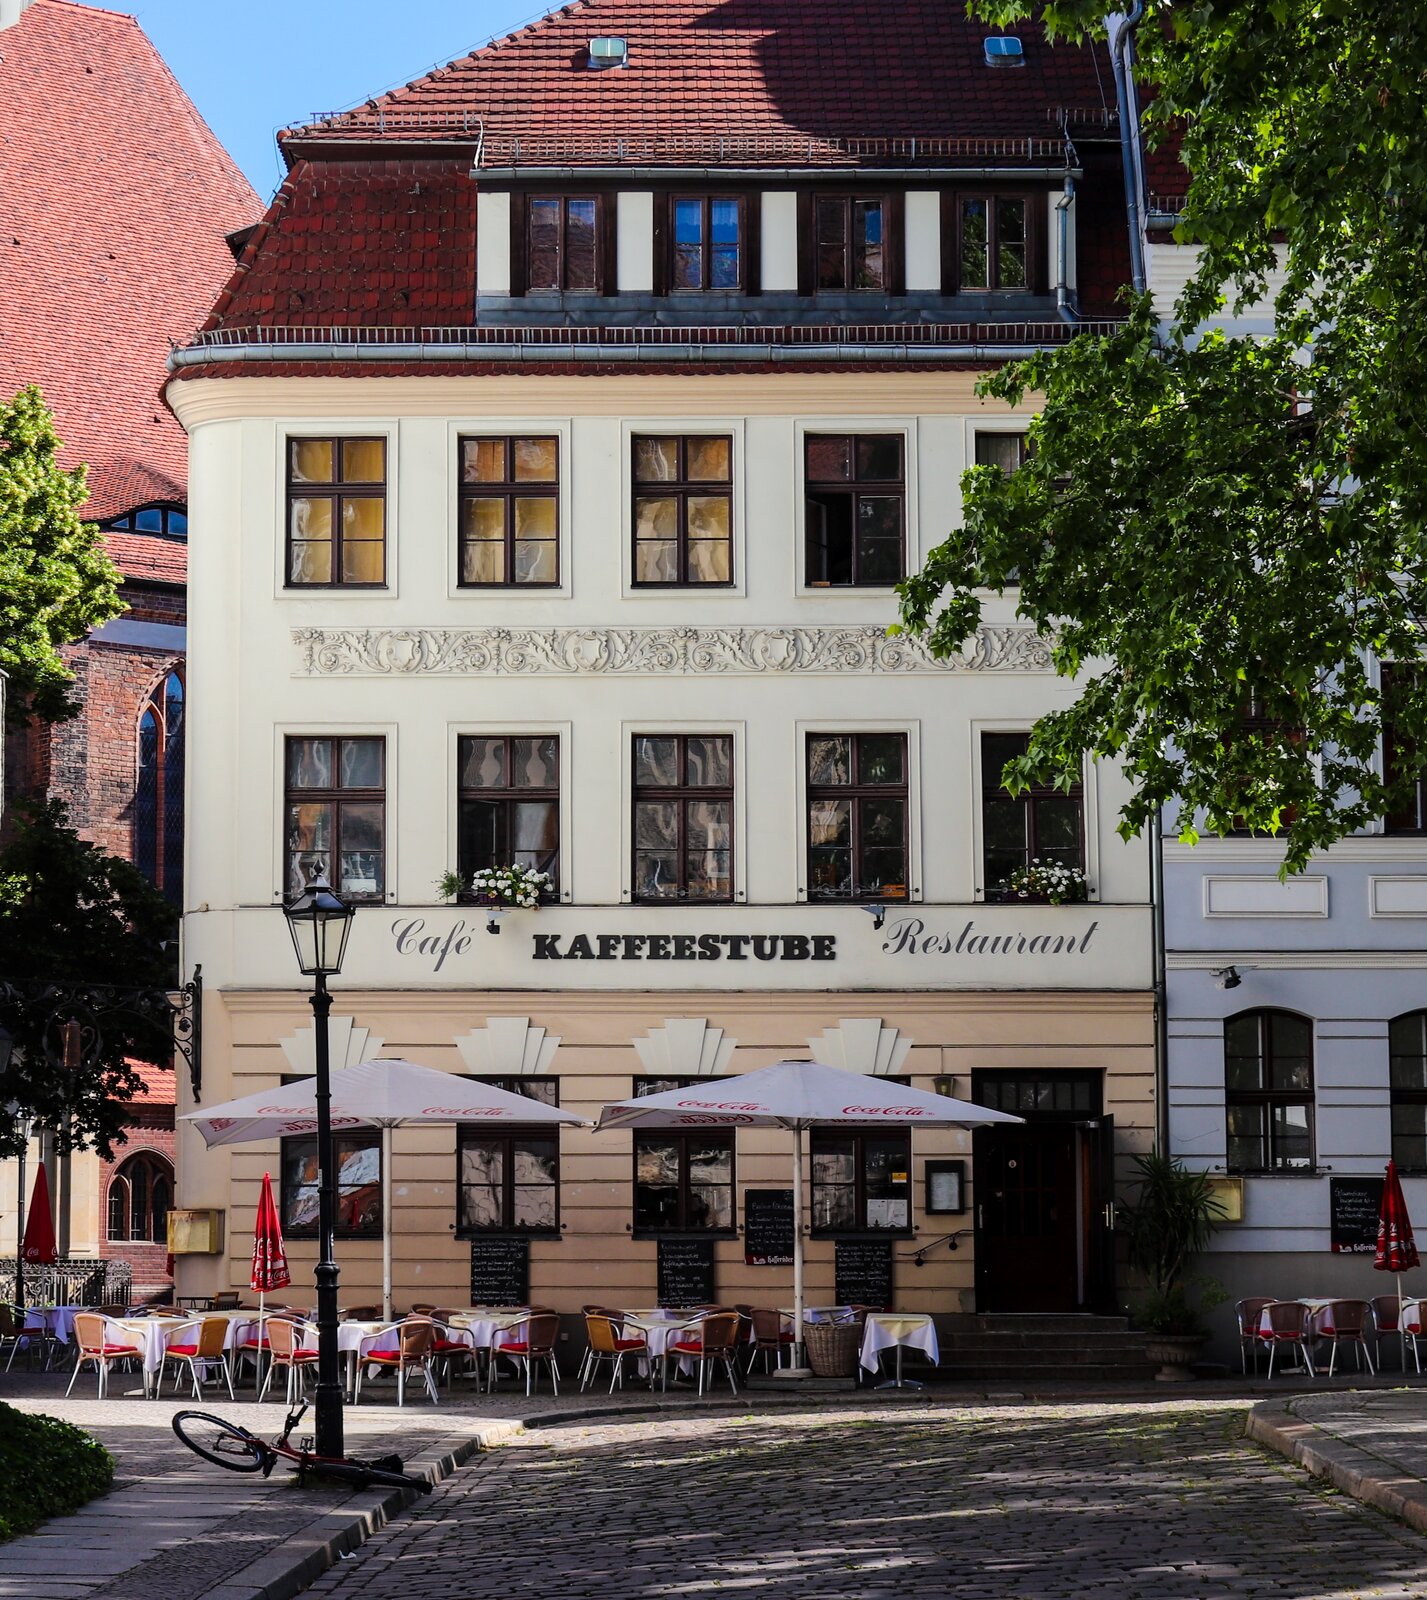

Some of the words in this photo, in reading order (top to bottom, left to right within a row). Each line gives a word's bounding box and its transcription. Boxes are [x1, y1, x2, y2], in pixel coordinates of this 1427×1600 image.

[391, 917, 474, 973] Café
[532, 934, 836, 960] KAFFEESTUBE
[882, 917, 1100, 955] Restaurant
[1353, 1243, 1377, 1252] Hasseröde
